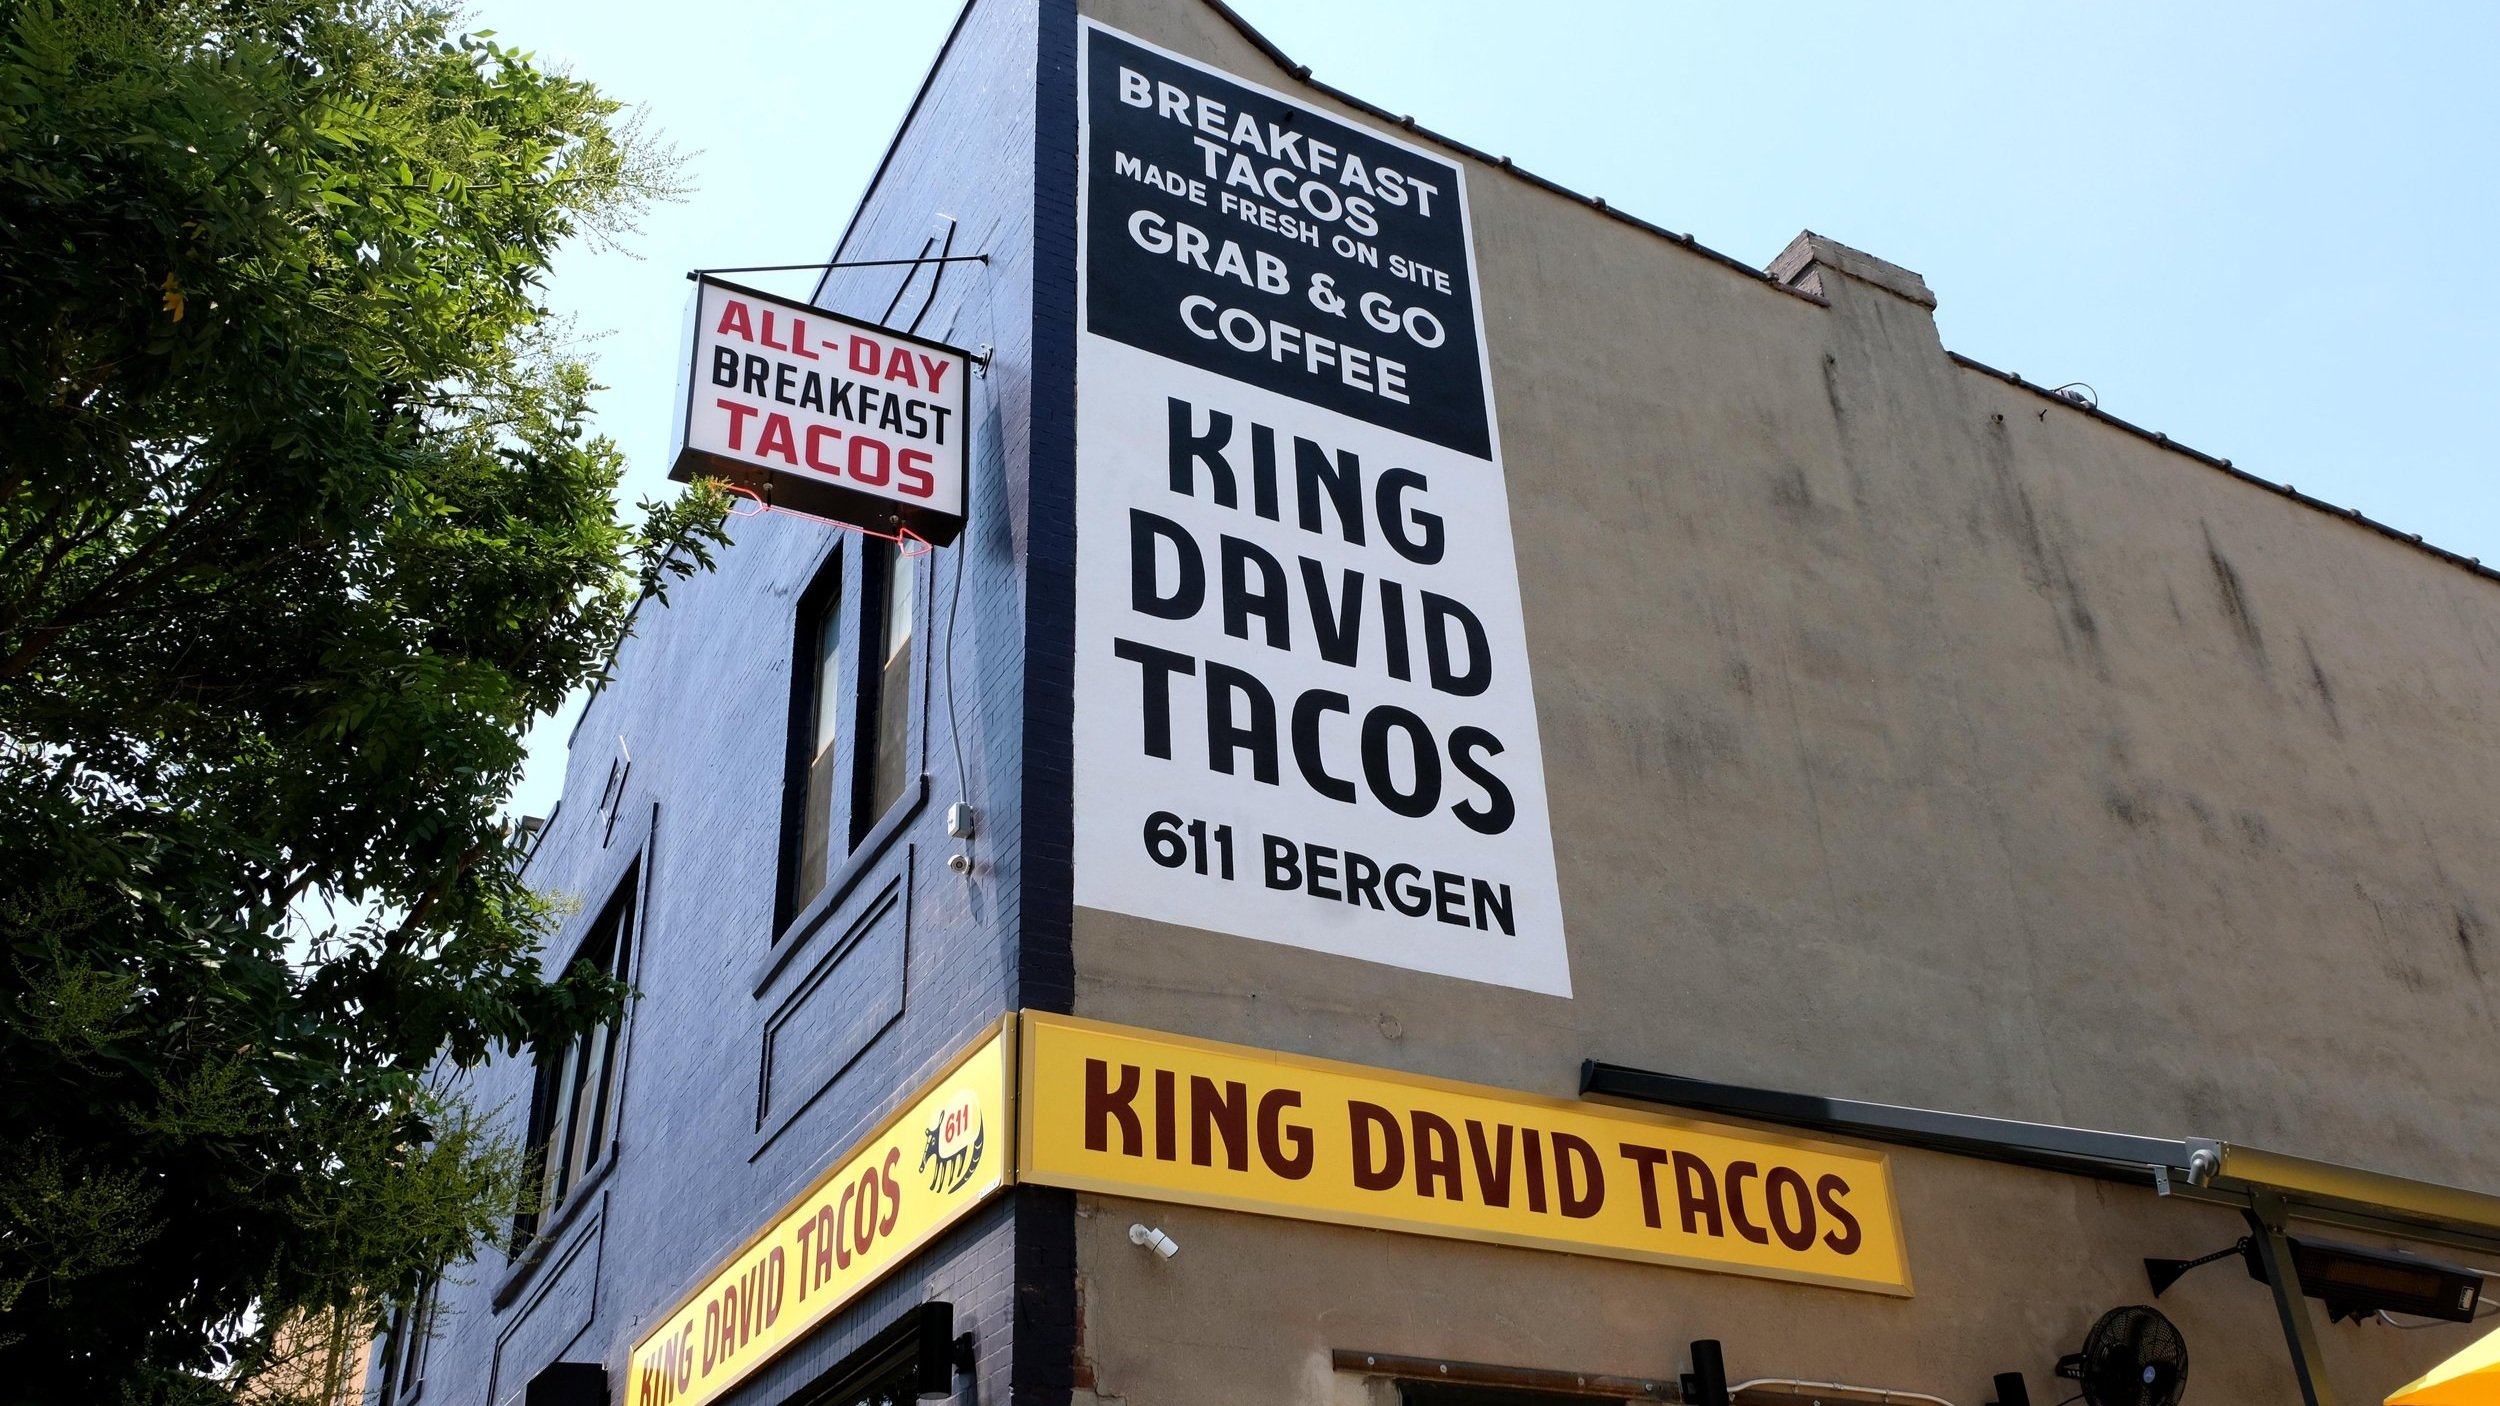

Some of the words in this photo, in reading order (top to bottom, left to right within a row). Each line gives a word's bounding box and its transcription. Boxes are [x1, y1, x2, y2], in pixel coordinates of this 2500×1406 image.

[1119, 66, 1438, 218] BREAKFAST
[1193, 136, 1379, 237] TACOS
[1115, 151, 1208, 207] MADE
[1220, 191, 1319, 248] FRESH
[1331, 234, 1378, 268] ON
[1388, 254, 1452, 295] SITE
[1127, 209, 1291, 295] GRAB
[1308, 272, 1347, 319] &
[1360, 291, 1446, 349] GO
[712, 344, 952, 446] BREAKFAST
[717, 300, 950, 394] ALL-DAY
[1179, 294, 1411, 405] COFFEE
[716, 398, 935, 499] TACOS
[1167, 395, 1445, 565] KING
[1129, 507, 1492, 697] DAVID
[1114, 637, 1516, 835] TACOS
[1142, 811, 1235, 881] 611
[1263, 833, 1516, 937] BERGEN
[945, 1104, 969, 1143] 611
[1084, 1058, 1314, 1181] KING
[1347, 1100, 1607, 1220] DAVID
[1620, 1143, 1862, 1256] TACOS
[640, 1319, 693, 1406] KING
[701, 1245, 784, 1378] DAVID
[797, 1146, 901, 1303] TACOS
